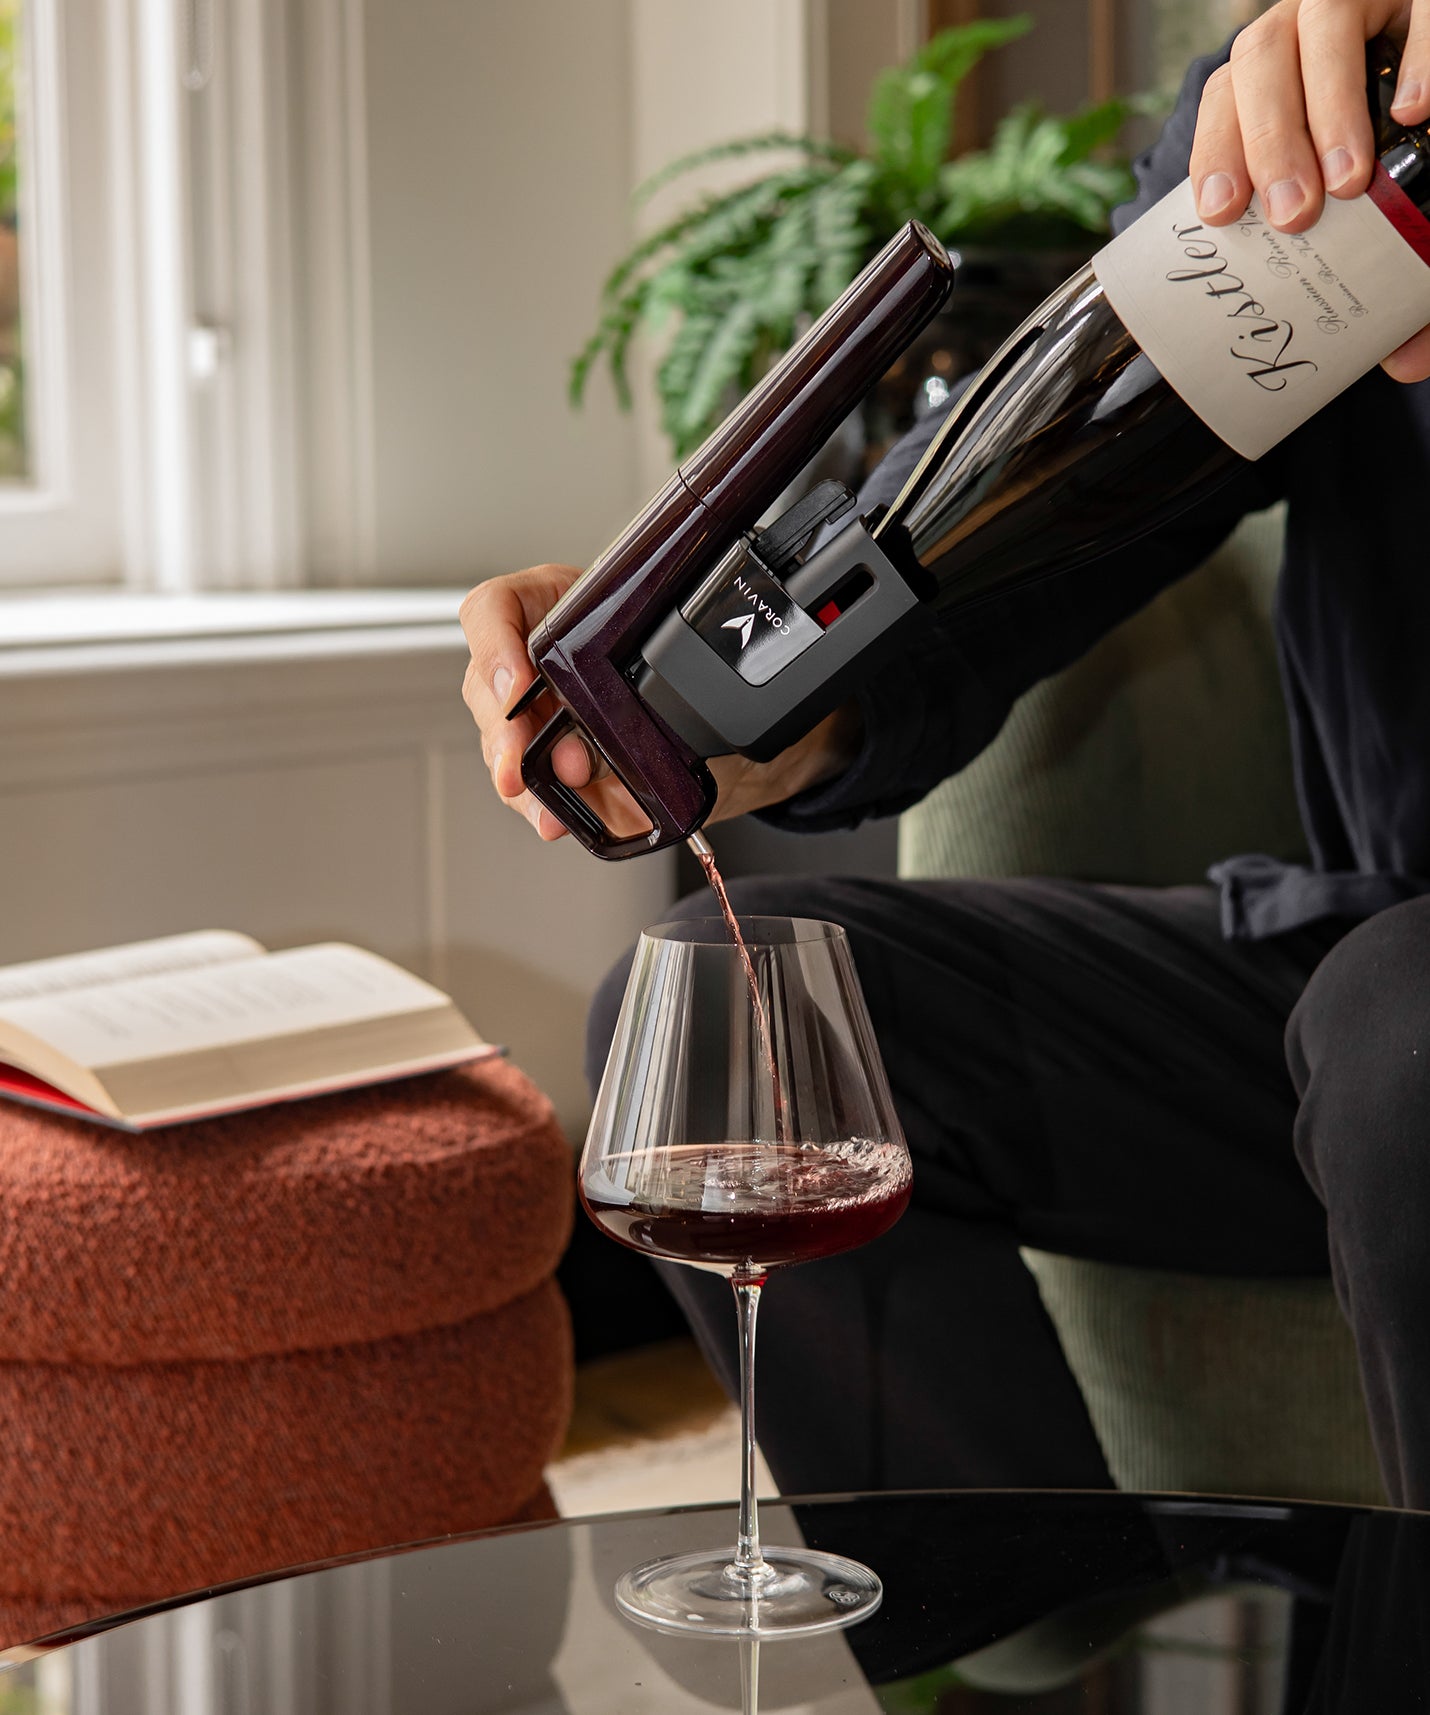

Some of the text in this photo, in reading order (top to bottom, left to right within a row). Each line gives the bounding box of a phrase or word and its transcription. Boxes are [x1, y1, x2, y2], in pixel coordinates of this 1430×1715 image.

[1262, 230, 1300, 280] River
[1314, 253, 1340, 285] River
[1166, 223, 1318, 392] Kistler
[1300, 277, 1349, 335] Russian
[1339, 282, 1369, 318] Russian
[733, 576, 790, 636] CORAVIN
